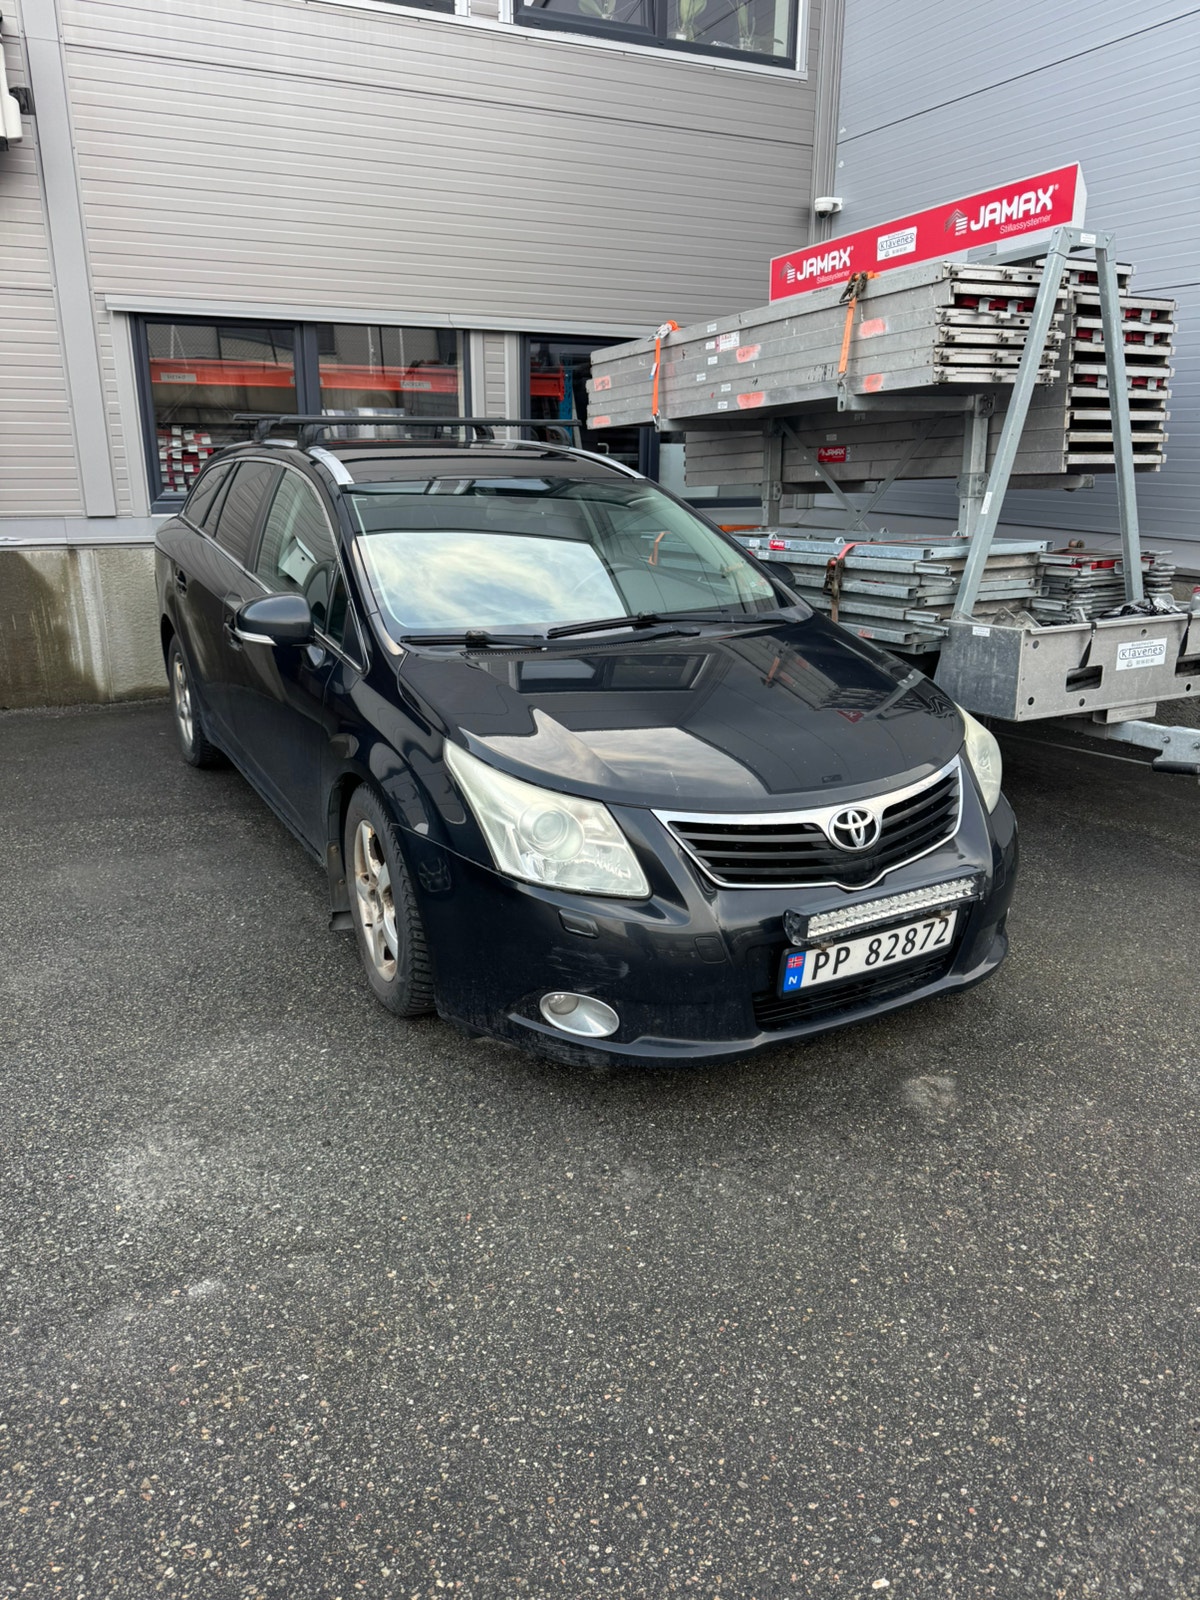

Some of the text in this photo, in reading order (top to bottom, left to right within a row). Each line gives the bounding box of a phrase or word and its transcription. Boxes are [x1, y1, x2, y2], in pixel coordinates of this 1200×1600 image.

[970, 185, 1054, 231] JAMAX
[999, 214, 1052, 235] Stillassystemer
[879, 233, 915, 250] Klavenes
[796, 247, 851, 281] JAMAX
[1121, 646, 1164, 658] Klavenes
[811, 919, 950, 980] PP 82872
[787, 975, 799, 986] N
